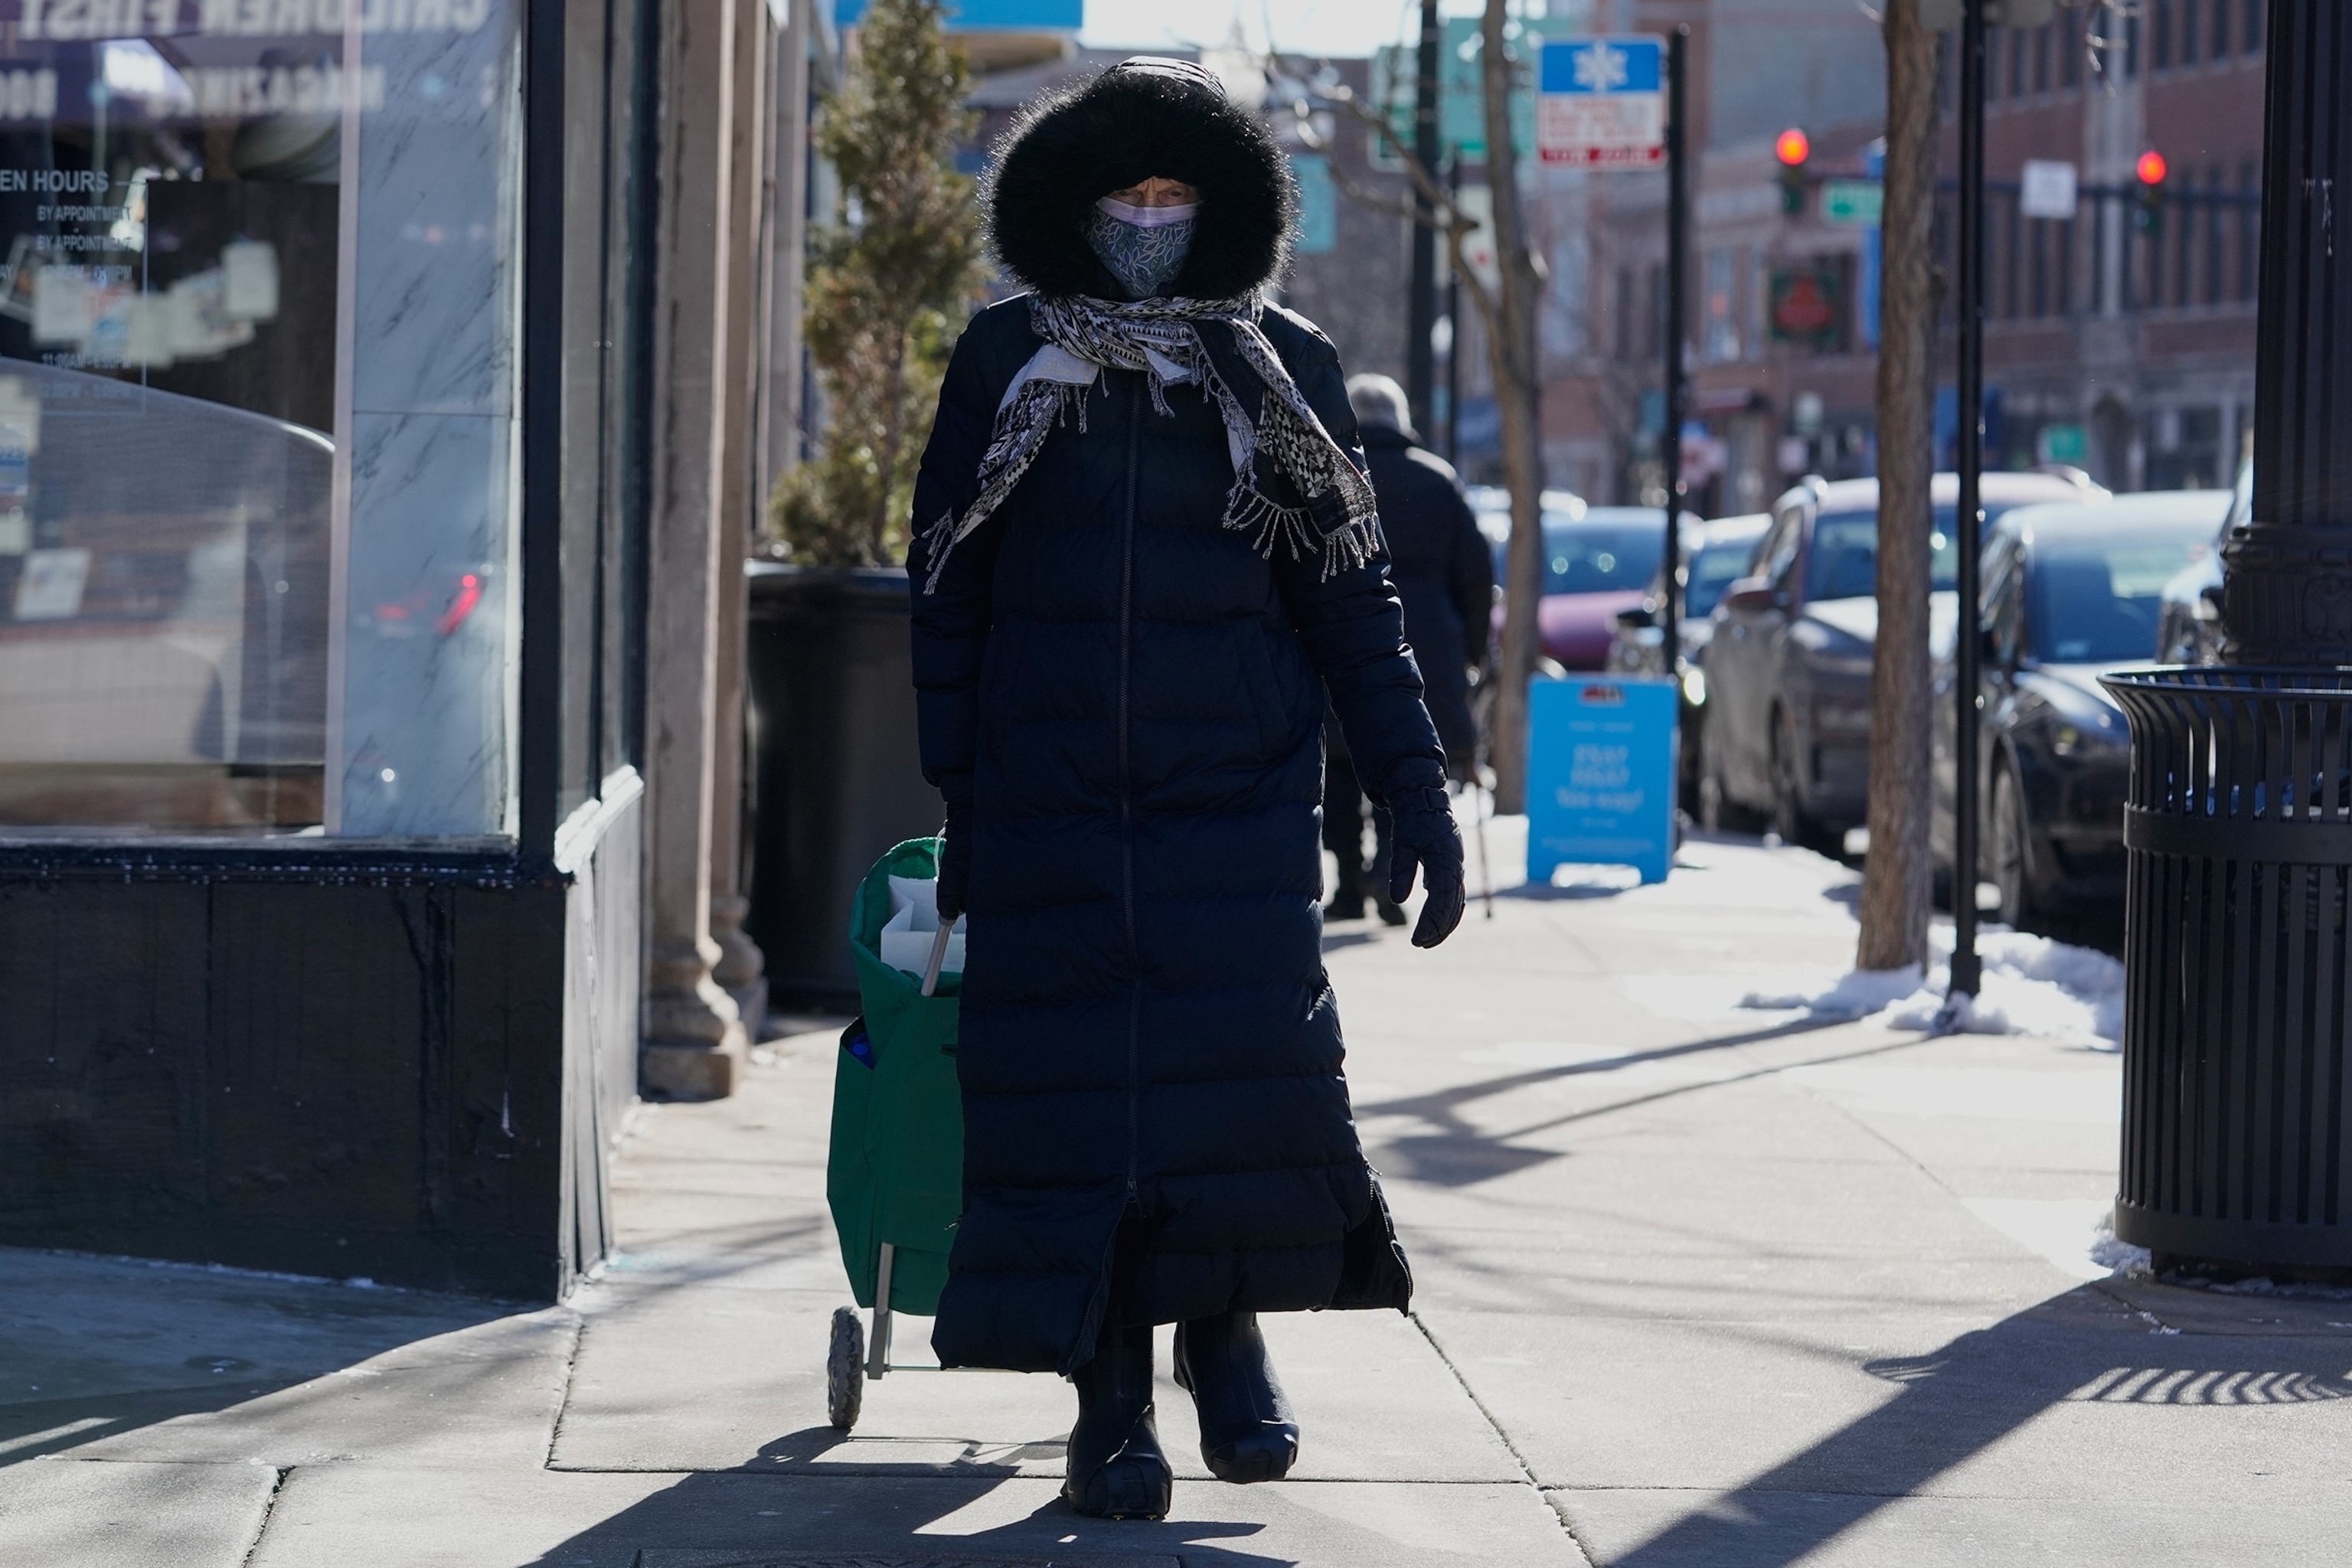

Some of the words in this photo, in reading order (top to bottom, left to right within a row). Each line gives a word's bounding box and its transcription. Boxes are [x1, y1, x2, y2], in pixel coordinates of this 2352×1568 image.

[34, 170, 109, 192] HOURS
[38, 204, 52, 221] BY
[37, 234, 52, 251] BY
